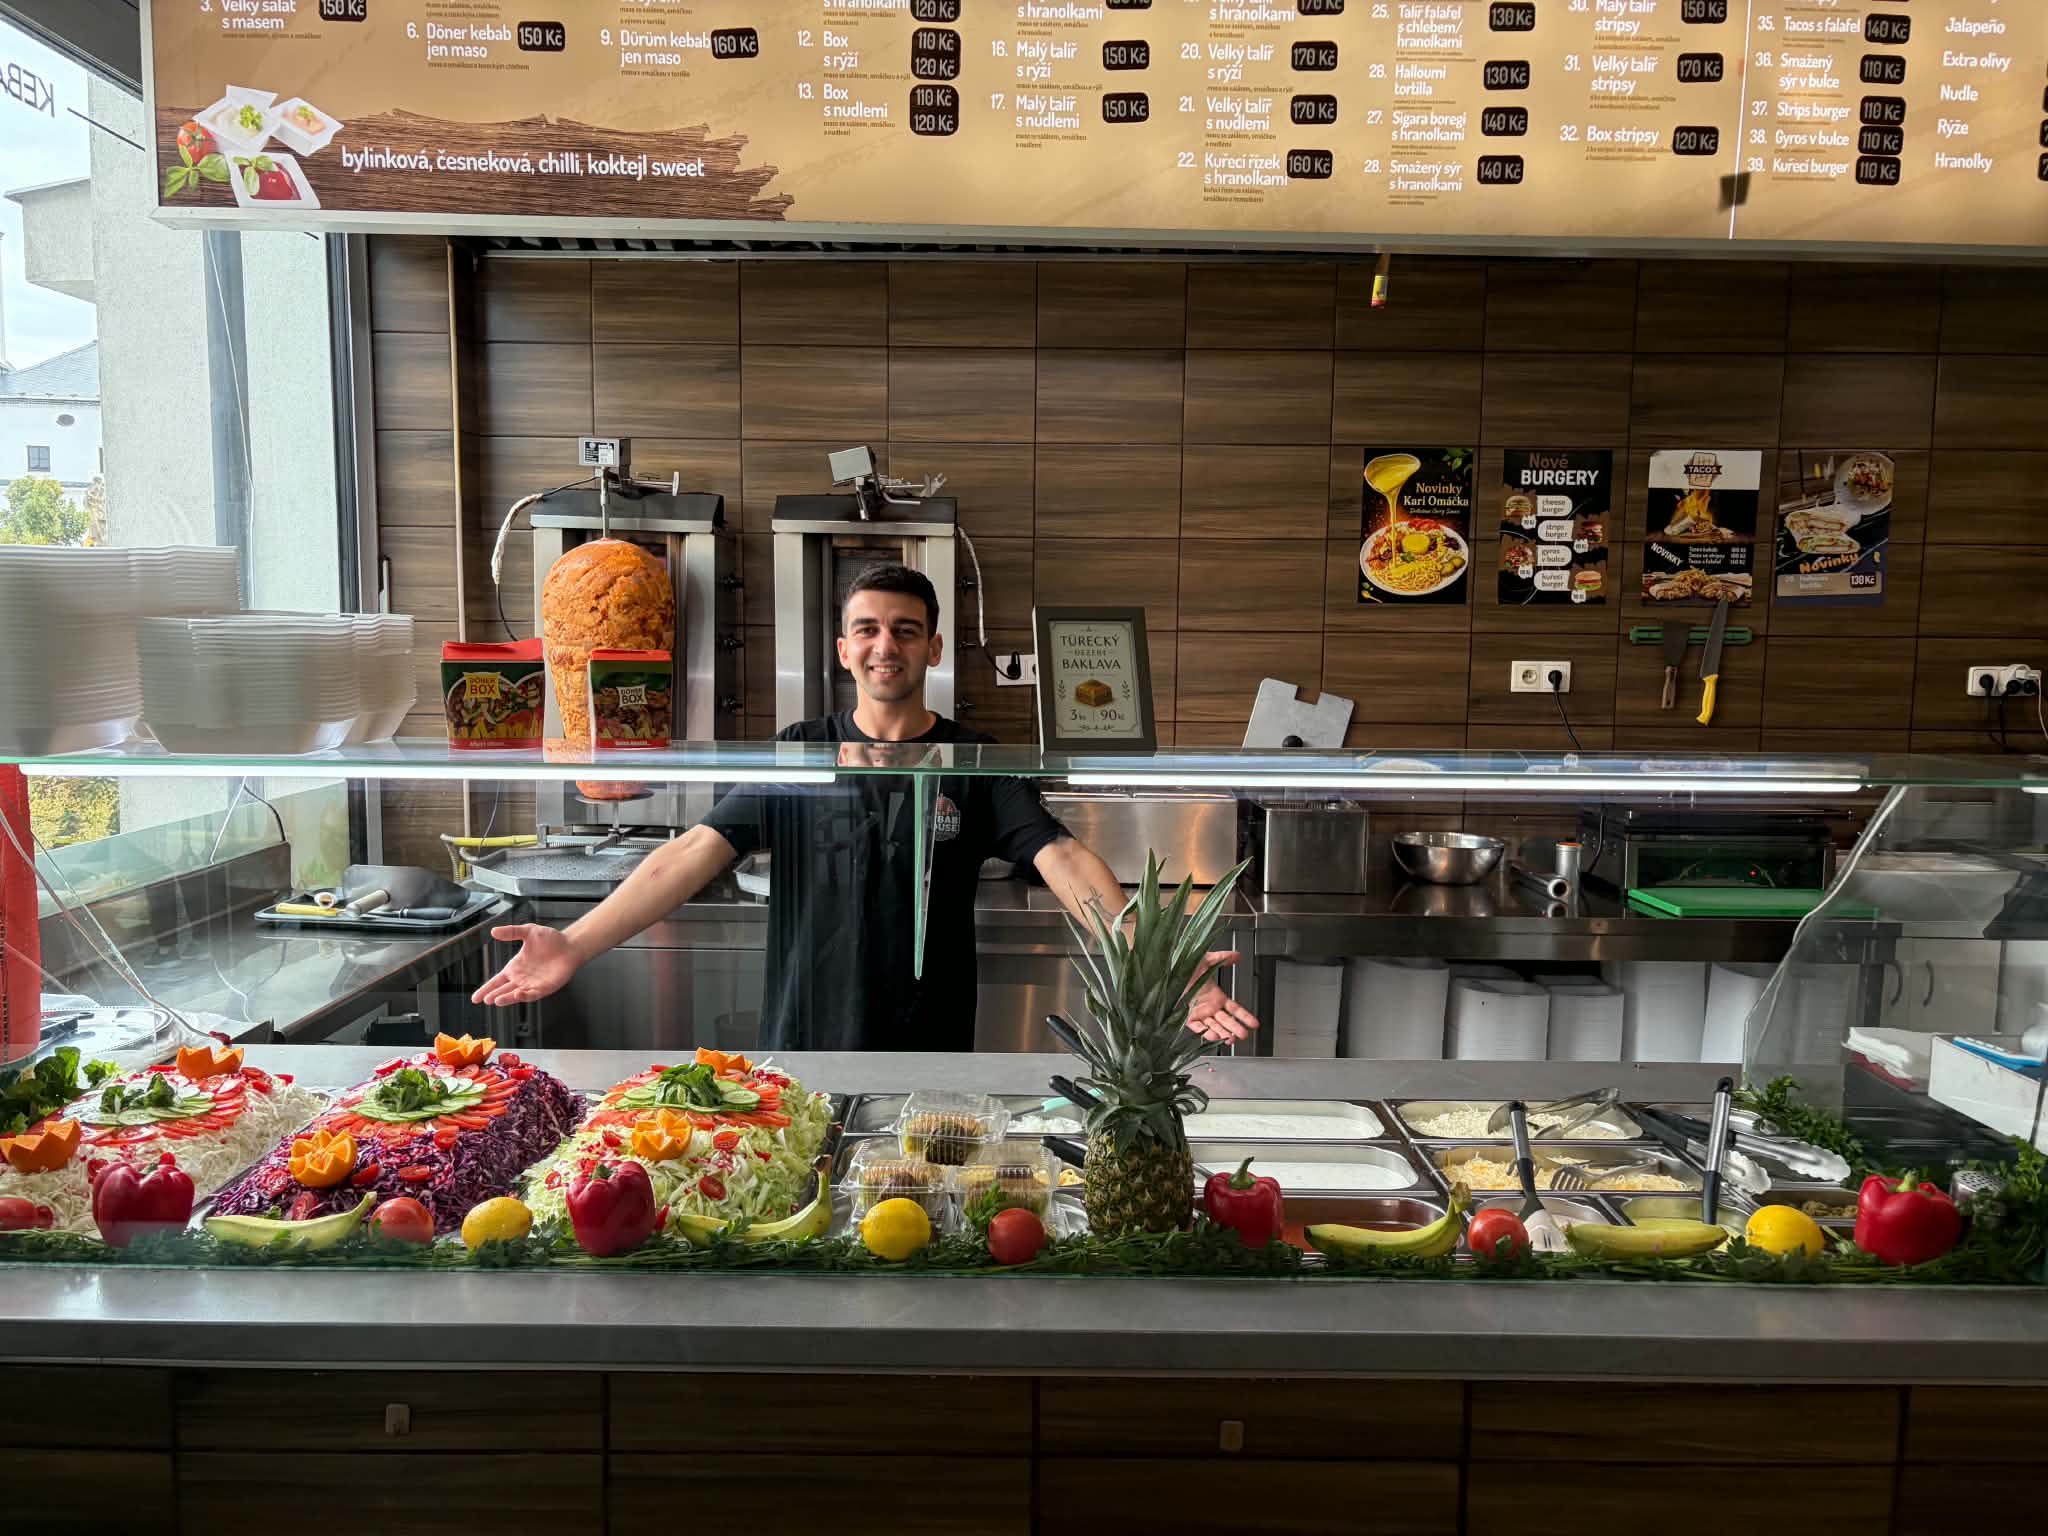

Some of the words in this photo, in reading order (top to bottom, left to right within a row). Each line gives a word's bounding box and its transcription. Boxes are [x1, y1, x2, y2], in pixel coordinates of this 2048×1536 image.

[200, 0, 213, 12] 3.
[322, 0, 346, 16] 150
[348, 0, 364, 17] Kč
[1018, 8, 1024, 18] s
[1027, 4, 1103, 20] hranolkami
[1210, 9, 1216, 20] s
[1219, 6, 1295, 21] hranolkami
[1372, 5, 1389, 19] 25.
[1399, 4, 1421, 19] Talíř
[1424, 4, 1461, 19] falafel
[1684, 3, 1704, 18] 150
[1708, 2, 1725, 18] Kč
[222, 18, 230, 29] s
[232, 17, 284, 30] masem
[1516, 9, 1533, 26] Kč
[1595, 18, 1640, 35] stripsy
[1758, 16, 1775, 32] 35.
[1784, 17, 1814, 33] Tacos
[1816, 22, 1823, 33] s
[1824, 18, 1860, 34] falafel
[407, 23, 419, 39] 6.
[427, 23, 467, 40] Döner
[470, 25, 511, 41] kebab
[1398, 23, 1404, 33] s
[1407, 20, 1463, 34] chlebem/
[1945, 18, 2006, 37] Jalapeño
[519, 27, 540, 45] 150
[546, 29, 563, 46] Kč
[601, 30, 614, 46] 9.
[621, 29, 667, 48] Dürüm
[670, 31, 711, 49] kebab
[714, 36, 736, 55] 160
[739, 35, 756, 53] Kč
[798, 31, 814, 47] 12.
[824, 31, 848, 48] Box
[918, 32, 935, 50] 110
[939, 33, 954, 51] Kč
[1397, 34, 1463, 49] hranolkami
[427, 41, 448, 60] jen
[451, 46, 487, 58] maso
[621, 48, 642, 67] jen
[645, 53, 681, 66] maso
[991, 40, 1008, 57] 16.
[1017, 41, 1047, 62] Malý
[1050, 42, 1077, 59] talíř
[1105, 47, 1127, 65] 150
[1131, 47, 1147, 64] Kč
[1208, 44, 1244, 64] Velký
[1247, 44, 1274, 60] talíř
[1293, 48, 1314, 66] 170
[1319, 49, 1335, 66] Kč
[824, 56, 830, 66] s
[834, 51, 858, 71] rýží
[915, 58, 935, 76] 120
[939, 59, 954, 77] Kč
[1564, 55, 1581, 72] 31.
[1592, 56, 1628, 76] Velký
[1631, 57, 1658, 73] talíř
[1680, 60, 1701, 77] 170
[1705, 60, 1720, 77] Kč
[1780, 52, 1832, 71] Smažený
[1943, 51, 1977, 68] Extra
[1980, 53, 2010, 72] olivy
[1017, 67, 1023, 77] s
[1027, 62, 1051, 81] rýží
[1208, 69, 1215, 79] s
[1217, 64, 1241, 83] rýží
[1395, 64, 1446, 79] Halloumi
[1885, 61, 1900, 80] Kč
[1394, 82, 1433, 96] tortilla
[1591, 78, 1636, 95] stripsy
[1779, 74, 1798, 90] sýr
[1800, 78, 1807, 87] v
[1809, 74, 1839, 89] bulce
[798, 84, 814, 100] 13.
[824, 84, 848, 100] Box
[916, 89, 932, 106] 110
[936, 90, 952, 107] Kč
[1940, 85, 1978, 102] Nudle
[824, 106, 830, 117] s
[833, 102, 888, 118] nudlemi
[991, 93, 1006, 111] 17.
[1016, 95, 1047, 115] Malý
[1050, 95, 1077, 112] talíř
[1105, 100, 1127, 118] 150
[1131, 100, 1147, 117] Kč
[1179, 96, 1195, 112] 21.
[1206, 97, 1242, 117] Velký
[1246, 98, 1272, 113] talíř
[1293, 102, 1314, 120] 170
[1318, 102, 1335, 119] Kč
[1752, 101, 1768, 116] 37.
[1777, 102, 1810, 118] Strips
[1812, 103, 1850, 120] burger
[914, 114, 935, 132] 120
[938, 115, 954, 132] Kč
[1016, 117, 1023, 127] s
[1025, 112, 1080, 129] nudlemi
[1206, 120, 1213, 130] s
[1216, 115, 1270, 131] nudlemi
[1367, 110, 1383, 125] 27.
[1392, 111, 1428, 127] Sigara
[1430, 112, 1467, 128] boregi
[1509, 114, 1526, 131] Kč
[1937, 118, 1969, 138] Rýže
[1392, 131, 1398, 141] s
[1400, 128, 1464, 142] hranolkami
[1560, 126, 1579, 142] 32.
[1586, 126, 1613, 142] Box
[1614, 128, 1659, 145] stripsy
[1675, 132, 1697, 150] 120
[1700, 133, 1716, 150] Kč
[1775, 131, 1808, 147] Gyros
[1809, 135, 1816, 144] v
[1818, 132, 1849, 146] bulce
[342, 145, 433, 173] bylinková,
[437, 150, 535, 174] česneková,
[539, 152, 584, 176] chilli,
[588, 153, 648, 181] koktejl
[651, 157, 705, 177] sweet
[1177, 152, 1197, 168] 22.
[1204, 153, 1247, 169] Kuřecí
[1249, 153, 1280, 169] řízek
[1289, 155, 1311, 173] 160
[1315, 156, 1331, 174] Kč
[1935, 153, 1993, 173] Hranolky
[1204, 174, 1211, 184] s
[1214, 170, 1289, 187] hranolkami
[1529, 453, 1569, 469] Nové
[1689, 465, 1718, 474] TACOS
[1520, 469, 1599, 486] BURGERY
[1416, 482, 1462, 497] Novinky
[1651, 542, 1683, 567] NOVINKY
[1800, 553, 1859, 574] Novinky
[1062, 658, 1121, 670] BAKLAVA
[470, 685, 496, 695] BOX
[621, 695, 644, 704] BOX
[1071, 709, 1077, 721] 3
[1102, 709, 1117, 721] 90
